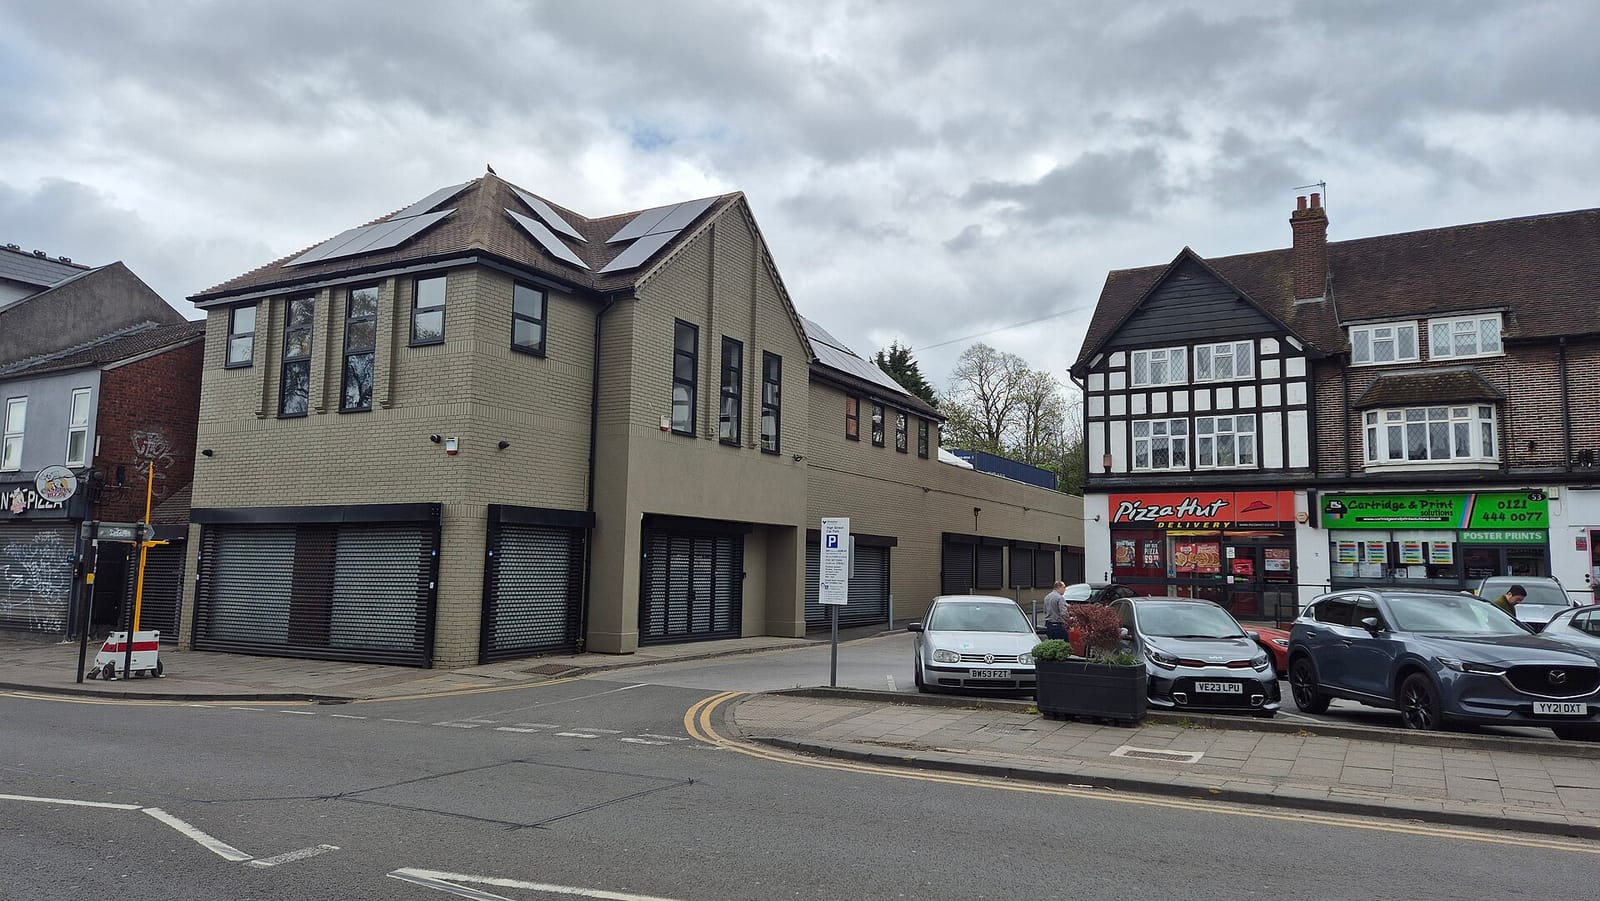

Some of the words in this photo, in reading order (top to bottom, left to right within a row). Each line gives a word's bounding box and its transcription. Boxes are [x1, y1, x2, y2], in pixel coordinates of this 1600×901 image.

[1531, 493, 1542, 501] 53
[1347, 500, 1406, 512] Cartridge
[1408, 500, 1418, 509] &
[1420, 499, 1454, 509] Print
[1498, 500, 1528, 510] 0121
[1113, 500, 1174, 524] Pizza
[1176, 497, 1229, 519] Hut
[1420, 509, 1454, 517] solutions
[1482, 511, 1506, 522] 444
[1510, 511, 1543, 521] 0077
[1463, 532, 1502, 540] POSTER
[1504, 532, 1542, 540] PRINTS
[828, 535, 836, 548] P
[1199, 683, 1221, 691] VE23
[1223, 684, 1240, 692] LPU
[1540, 703, 1562, 713] YY21
[1563, 704, 1581, 713] OXT
